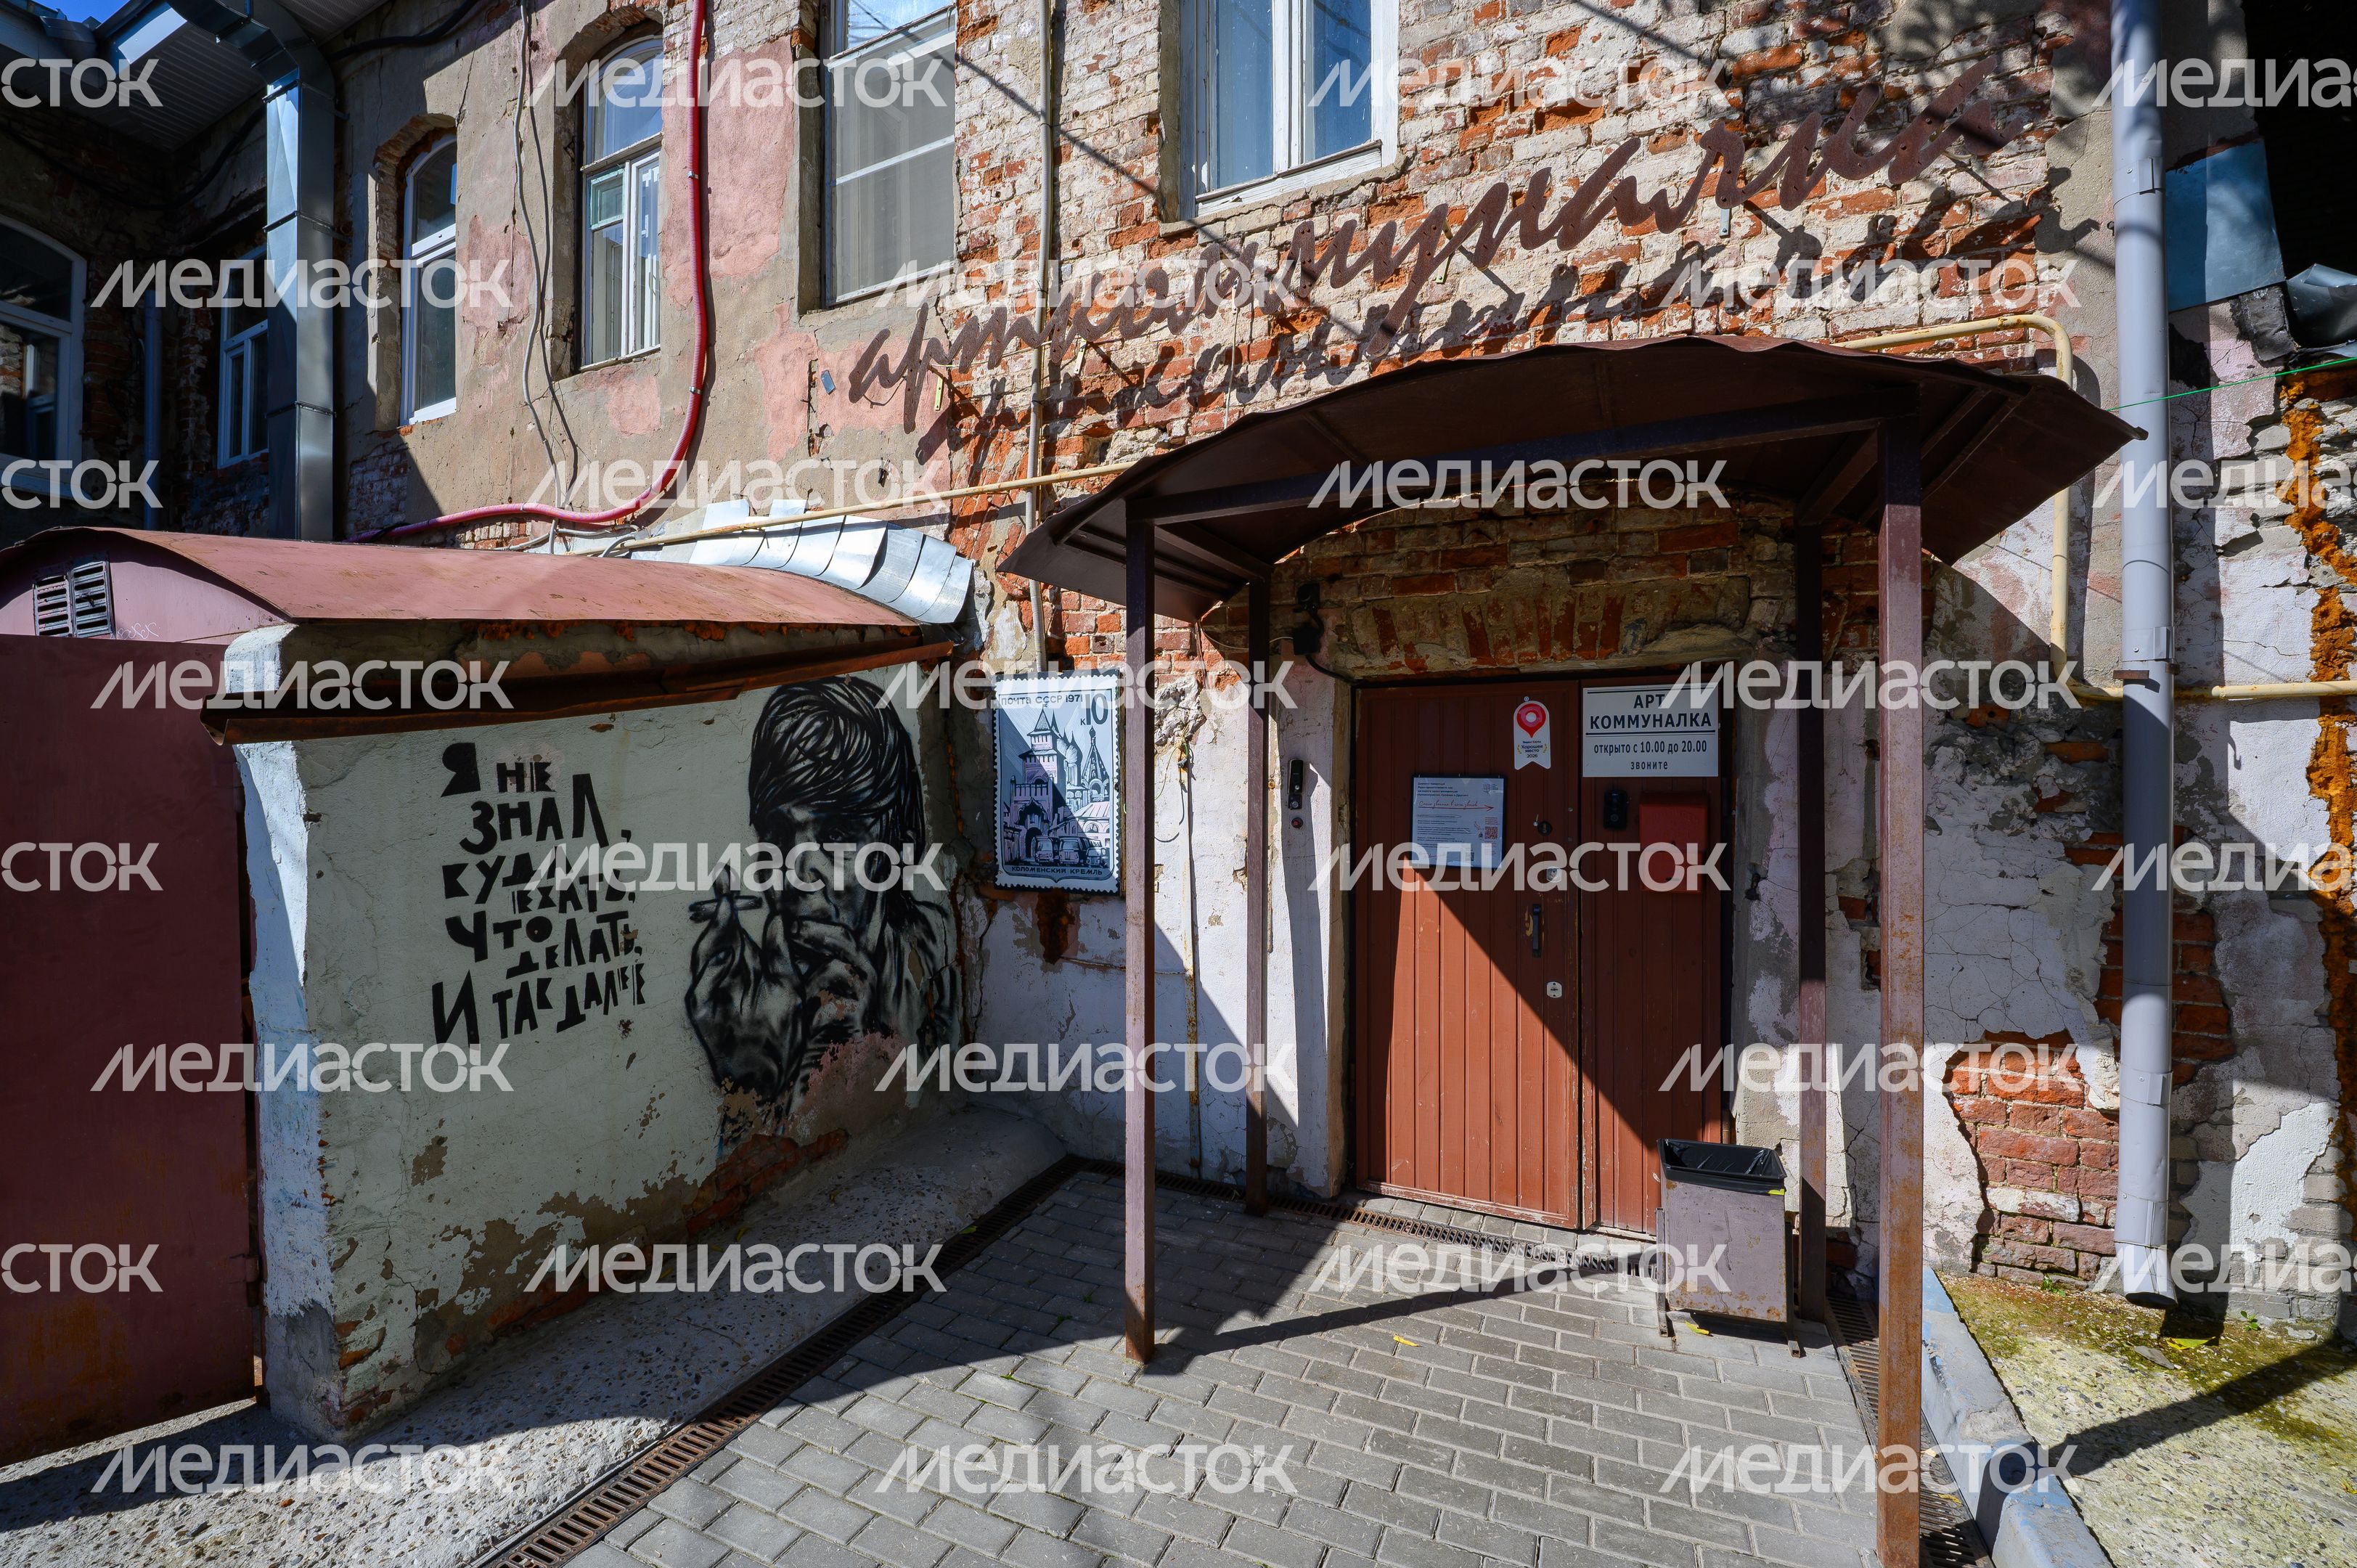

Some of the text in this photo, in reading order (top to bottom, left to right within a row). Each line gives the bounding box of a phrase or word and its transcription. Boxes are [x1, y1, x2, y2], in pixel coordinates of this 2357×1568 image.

[1035, 695, 1063, 704] СССР
[1066, 694, 1082, 703] 1971
[1633, 694, 1665, 709] АРТ
[1590, 712, 1712, 730] КОММУНАЛКА
[1594, 740, 1707, 756] открыто с 10.00 до 20.00
[1630, 761, 1668, 770] звоните
[441, 742, 556, 797] Я НЕ
[459, 773, 632, 854] ЗНАЛ,
[442, 846, 573, 904] КУДА
[445, 910, 552, 963] ЧТО
[432, 969, 480, 1053] И
[492, 977, 553, 1040] ТАК
